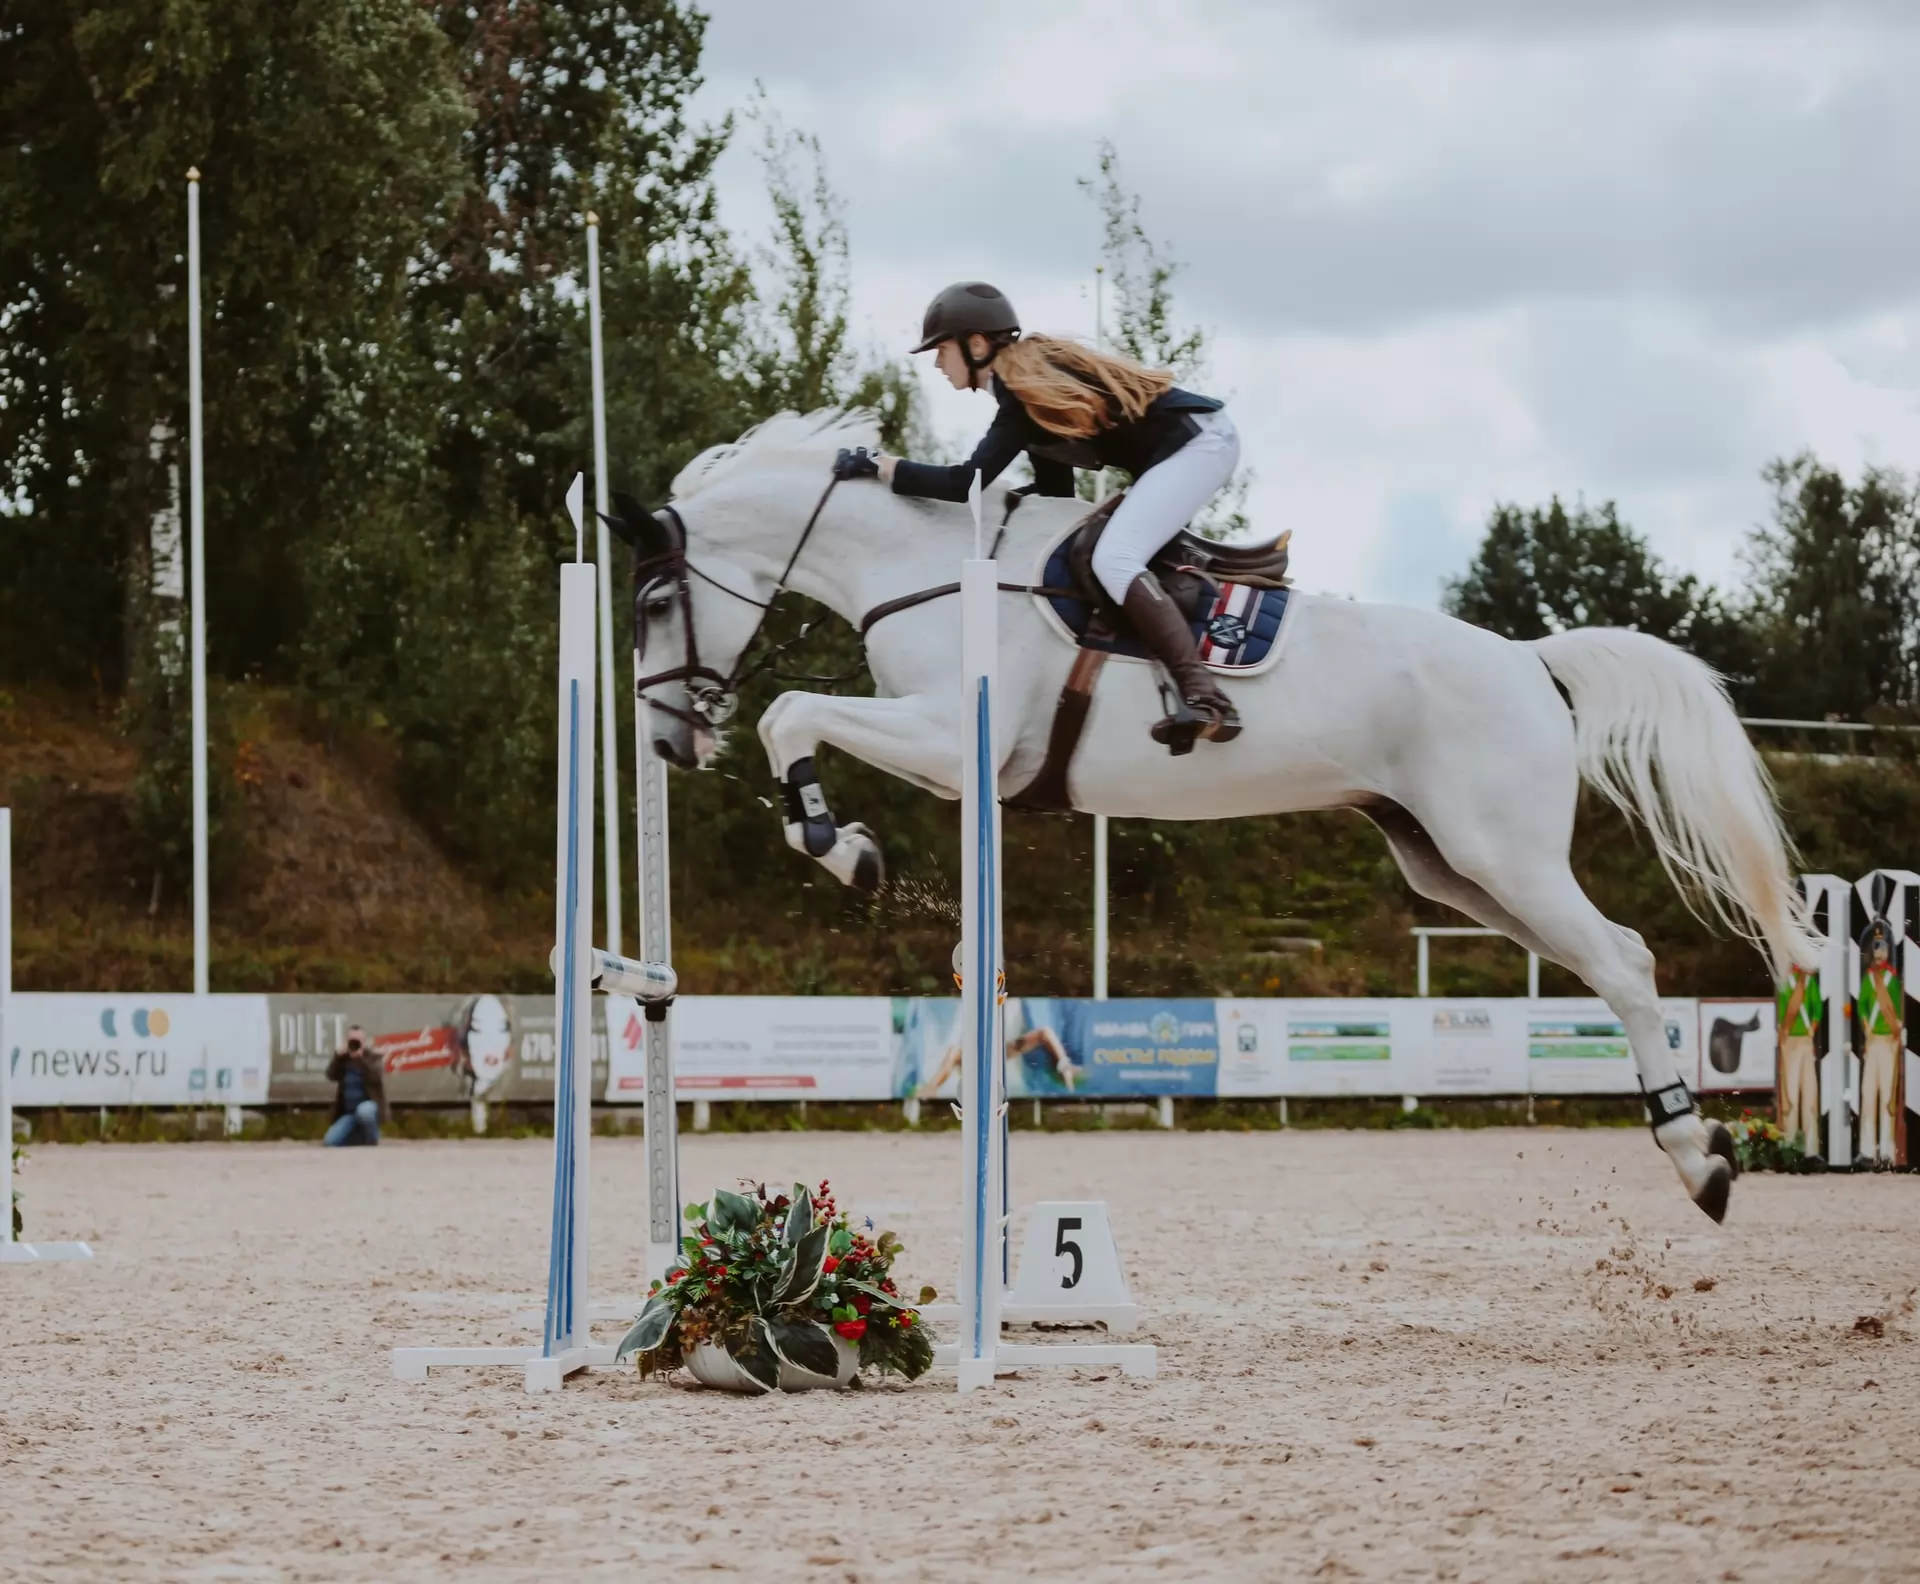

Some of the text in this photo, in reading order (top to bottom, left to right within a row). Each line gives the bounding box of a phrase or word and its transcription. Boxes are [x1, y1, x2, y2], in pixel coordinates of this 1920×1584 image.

[279, 1013, 348, 1055] DUET
[31, 1050, 166, 1077] news.ru
[1055, 1217, 1083, 1289] 5
